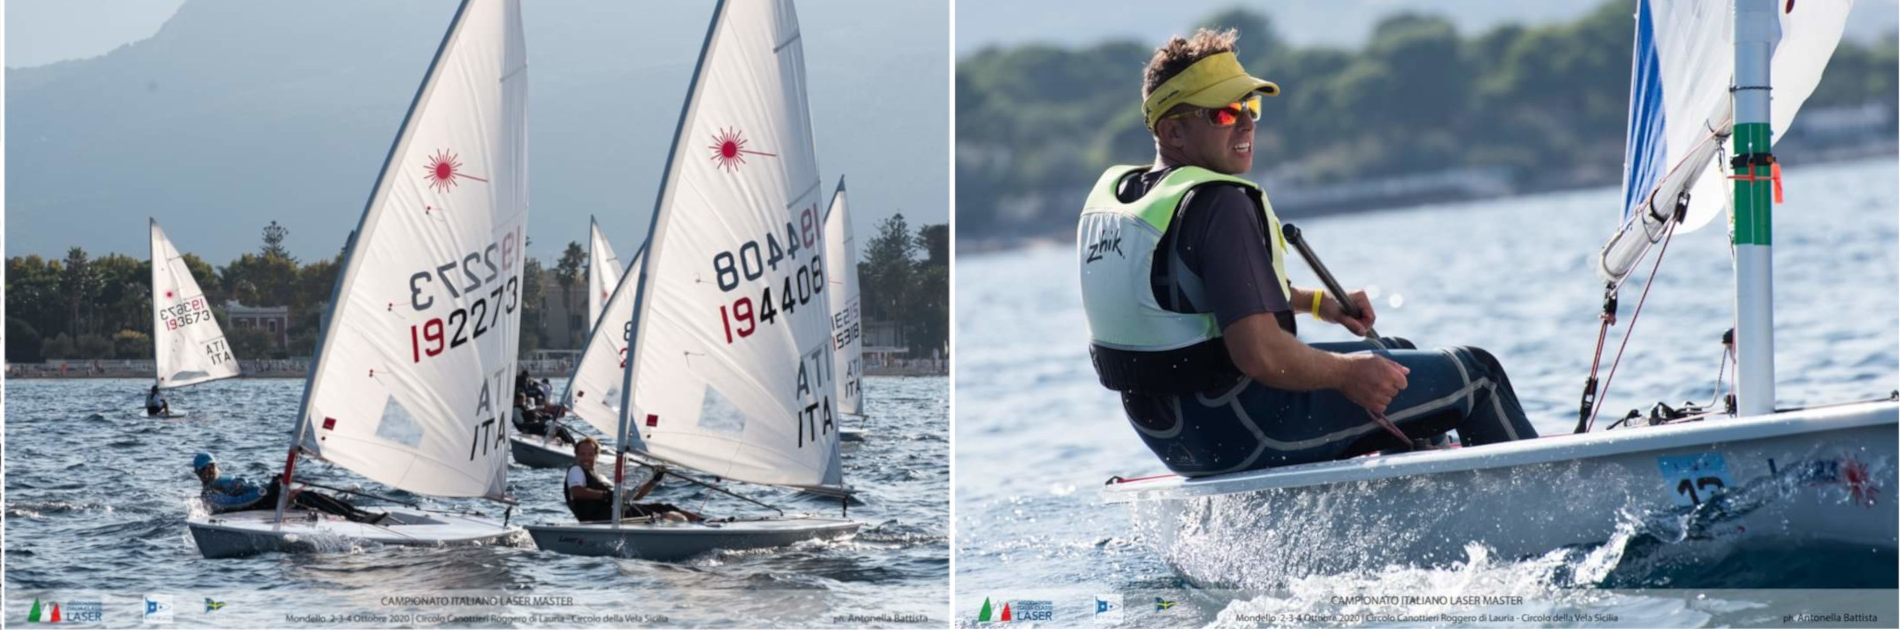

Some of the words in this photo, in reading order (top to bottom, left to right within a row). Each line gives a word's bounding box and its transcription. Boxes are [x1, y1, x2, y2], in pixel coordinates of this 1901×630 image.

[165, 309, 211, 331] 193673
[410, 275, 518, 363] 192273
[719, 255, 824, 344] 194408
[211, 351, 231, 365] ITA
[846, 378, 860, 399] ITA
[470, 411, 506, 461] ITA
[797, 395, 834, 448] ITA
